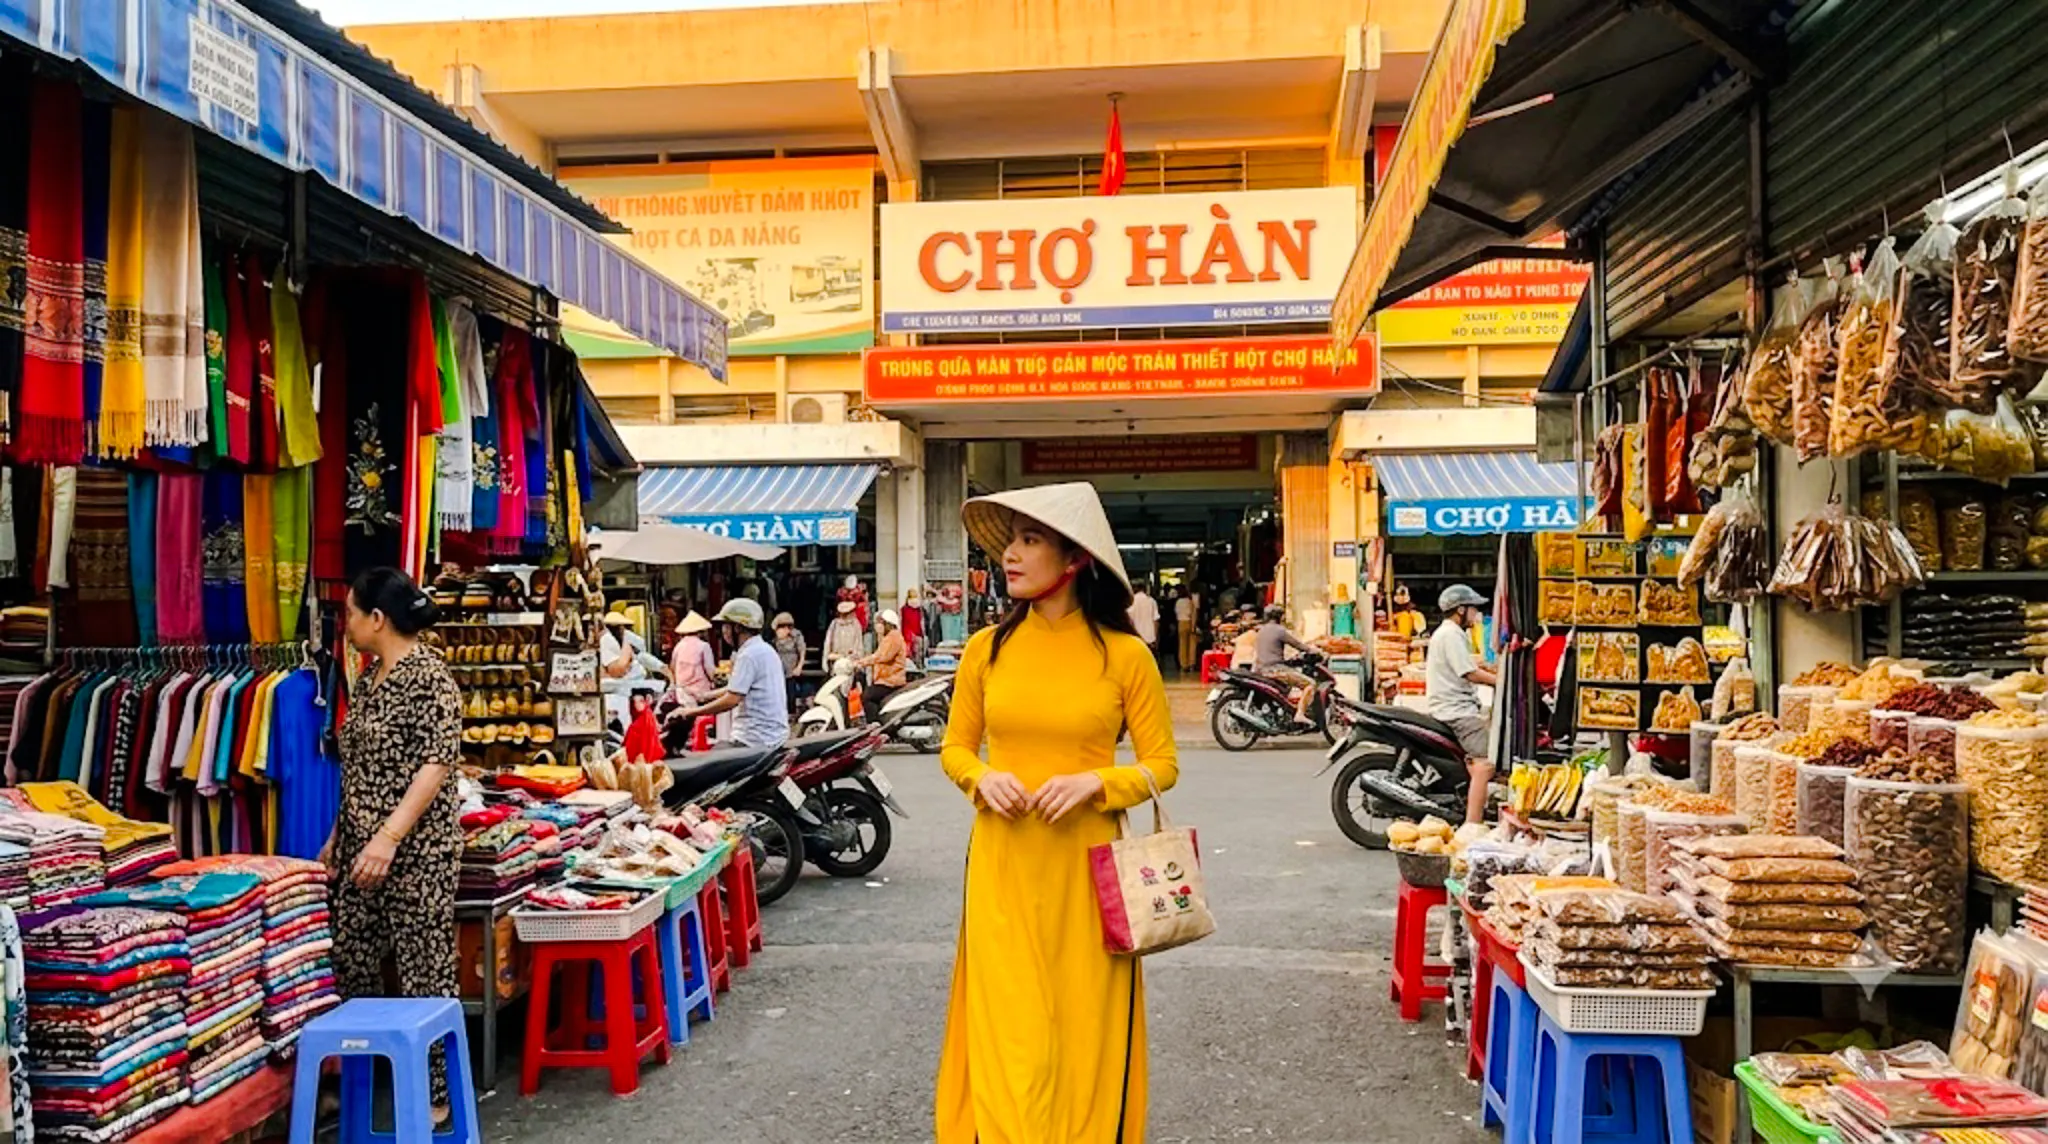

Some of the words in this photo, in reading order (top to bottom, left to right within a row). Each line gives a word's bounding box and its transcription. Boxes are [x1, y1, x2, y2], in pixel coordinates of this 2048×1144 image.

[918, 218, 1096, 304] CHỢ
[1125, 203, 1317, 287] HÀN
[1272, 345, 1308, 369] CHỢ
[740, 515, 815, 541] HÀN
[1434, 503, 1512, 533] CHỢ
